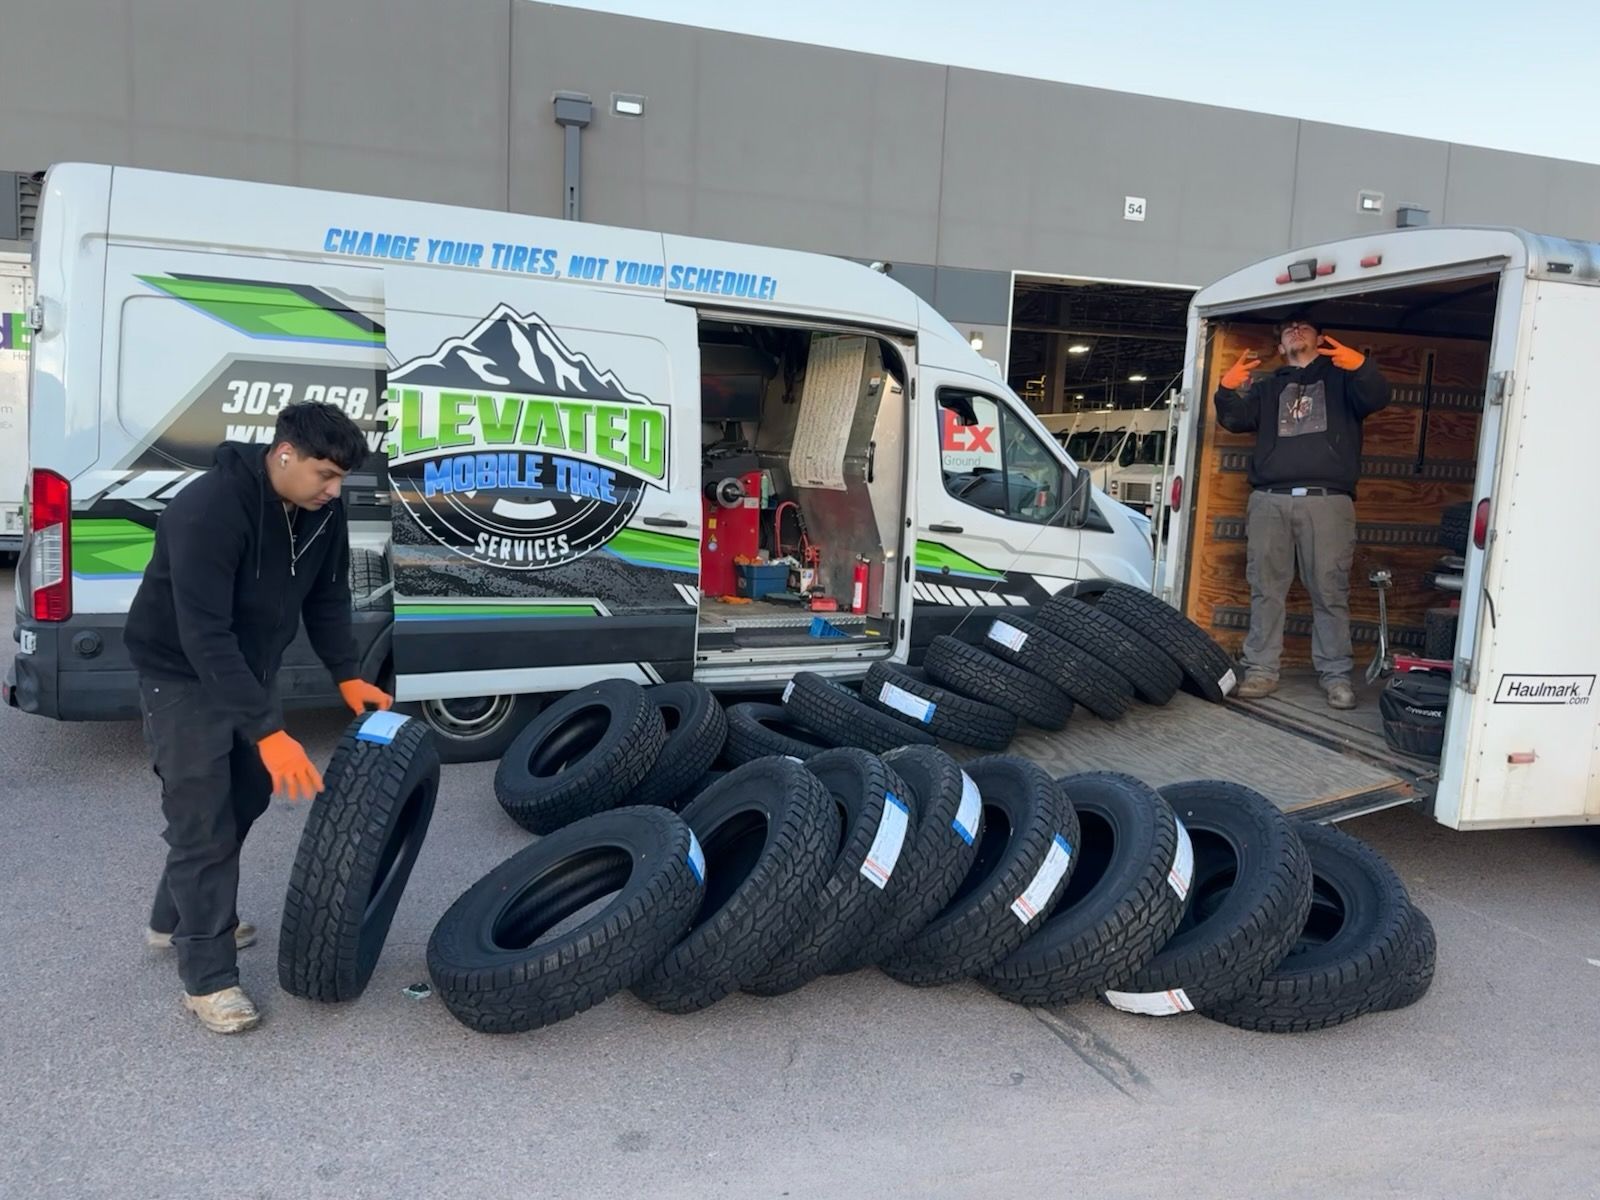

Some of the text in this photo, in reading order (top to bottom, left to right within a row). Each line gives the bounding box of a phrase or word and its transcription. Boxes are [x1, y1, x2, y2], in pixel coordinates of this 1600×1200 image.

[1128, 203, 1143, 215] 54
[323, 227, 777, 301] CHANGE YOUR TIRES, NOT YOUR SCHEDULE!
[938, 408, 995, 453] Ex
[943, 454, 981, 466] Ground
[424, 453, 618, 505] MOBILE TIRE
[474, 532, 570, 561] SERVICES
[1507, 682, 1580, 697] Haulmark
[1566, 696, 1590, 704] .com
